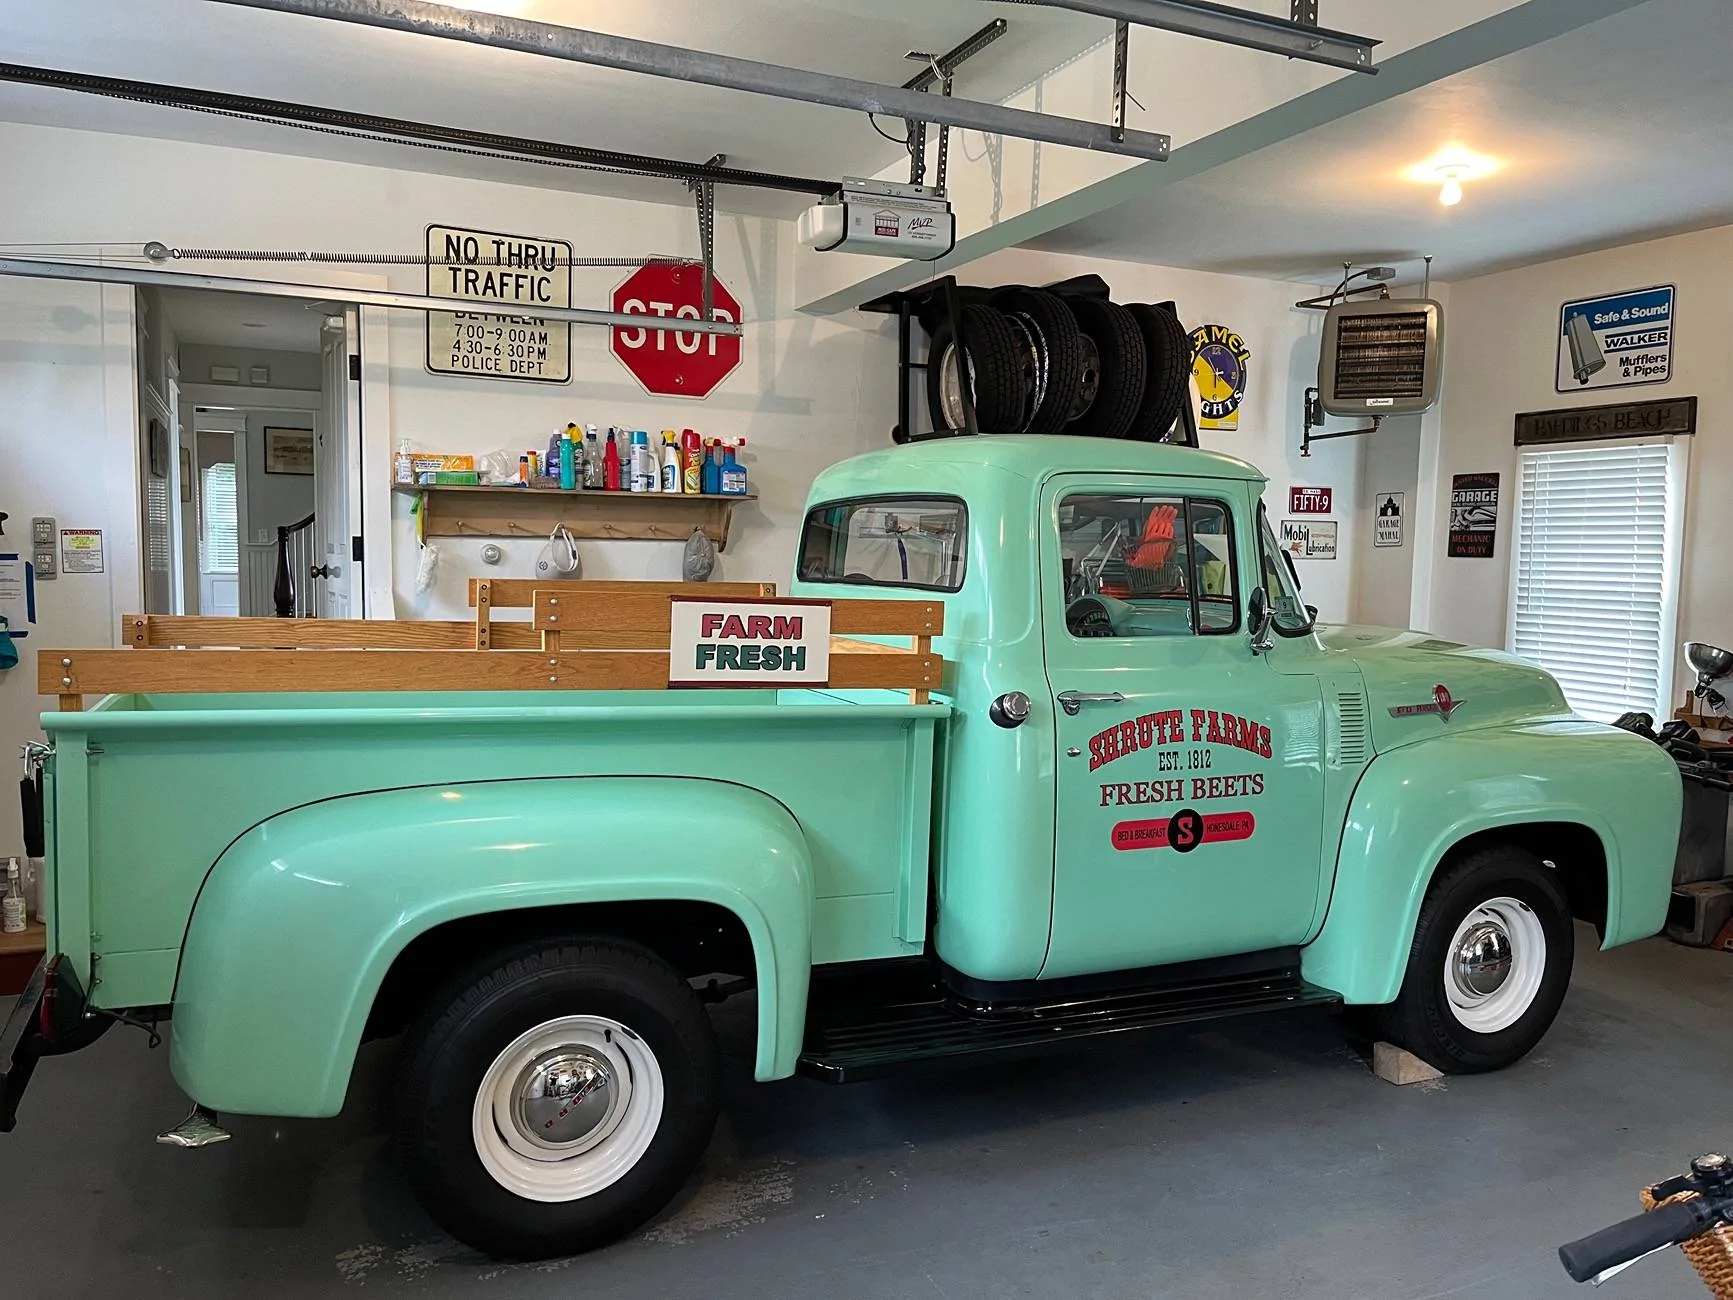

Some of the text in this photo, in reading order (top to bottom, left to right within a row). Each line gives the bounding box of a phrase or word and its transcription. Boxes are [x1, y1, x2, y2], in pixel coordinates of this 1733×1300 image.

[445, 233, 557, 272] NO THRU
[448, 267, 551, 303] TRAFFIC
[1594, 303, 1669, 325] Safe & Sound
[620, 298, 734, 356] STOP
[1604, 331, 1668, 349] WALKER
[451, 355, 502, 371] POLICE
[1619, 353, 1667, 367] Mufflers
[1622, 364, 1667, 378] & Pipes
[1200, 390, 1243, 415] GHTS
[1614, 408, 1670, 430] BEACH
[1294, 494, 1329, 511] FIFTY-9
[1452, 490, 1498, 503] GARAGE
[1378, 519, 1399, 529] GARAGE
[1451, 534, 1491, 543] MECHANIC
[1456, 545, 1487, 554] ON DUTY
[701, 613, 803, 640] FARM
[695, 644, 807, 671] FRESH
[1088, 709, 1273, 773] SHRUTE FARMS
[1158, 748, 1211, 771] EST. 1812
[1099, 773, 1265, 807] FRESH BEETS
[1117, 830, 1129, 841] BED
[1134, 827, 1166, 840] BREAKFAST
[1177, 816, 1194, 845] S
